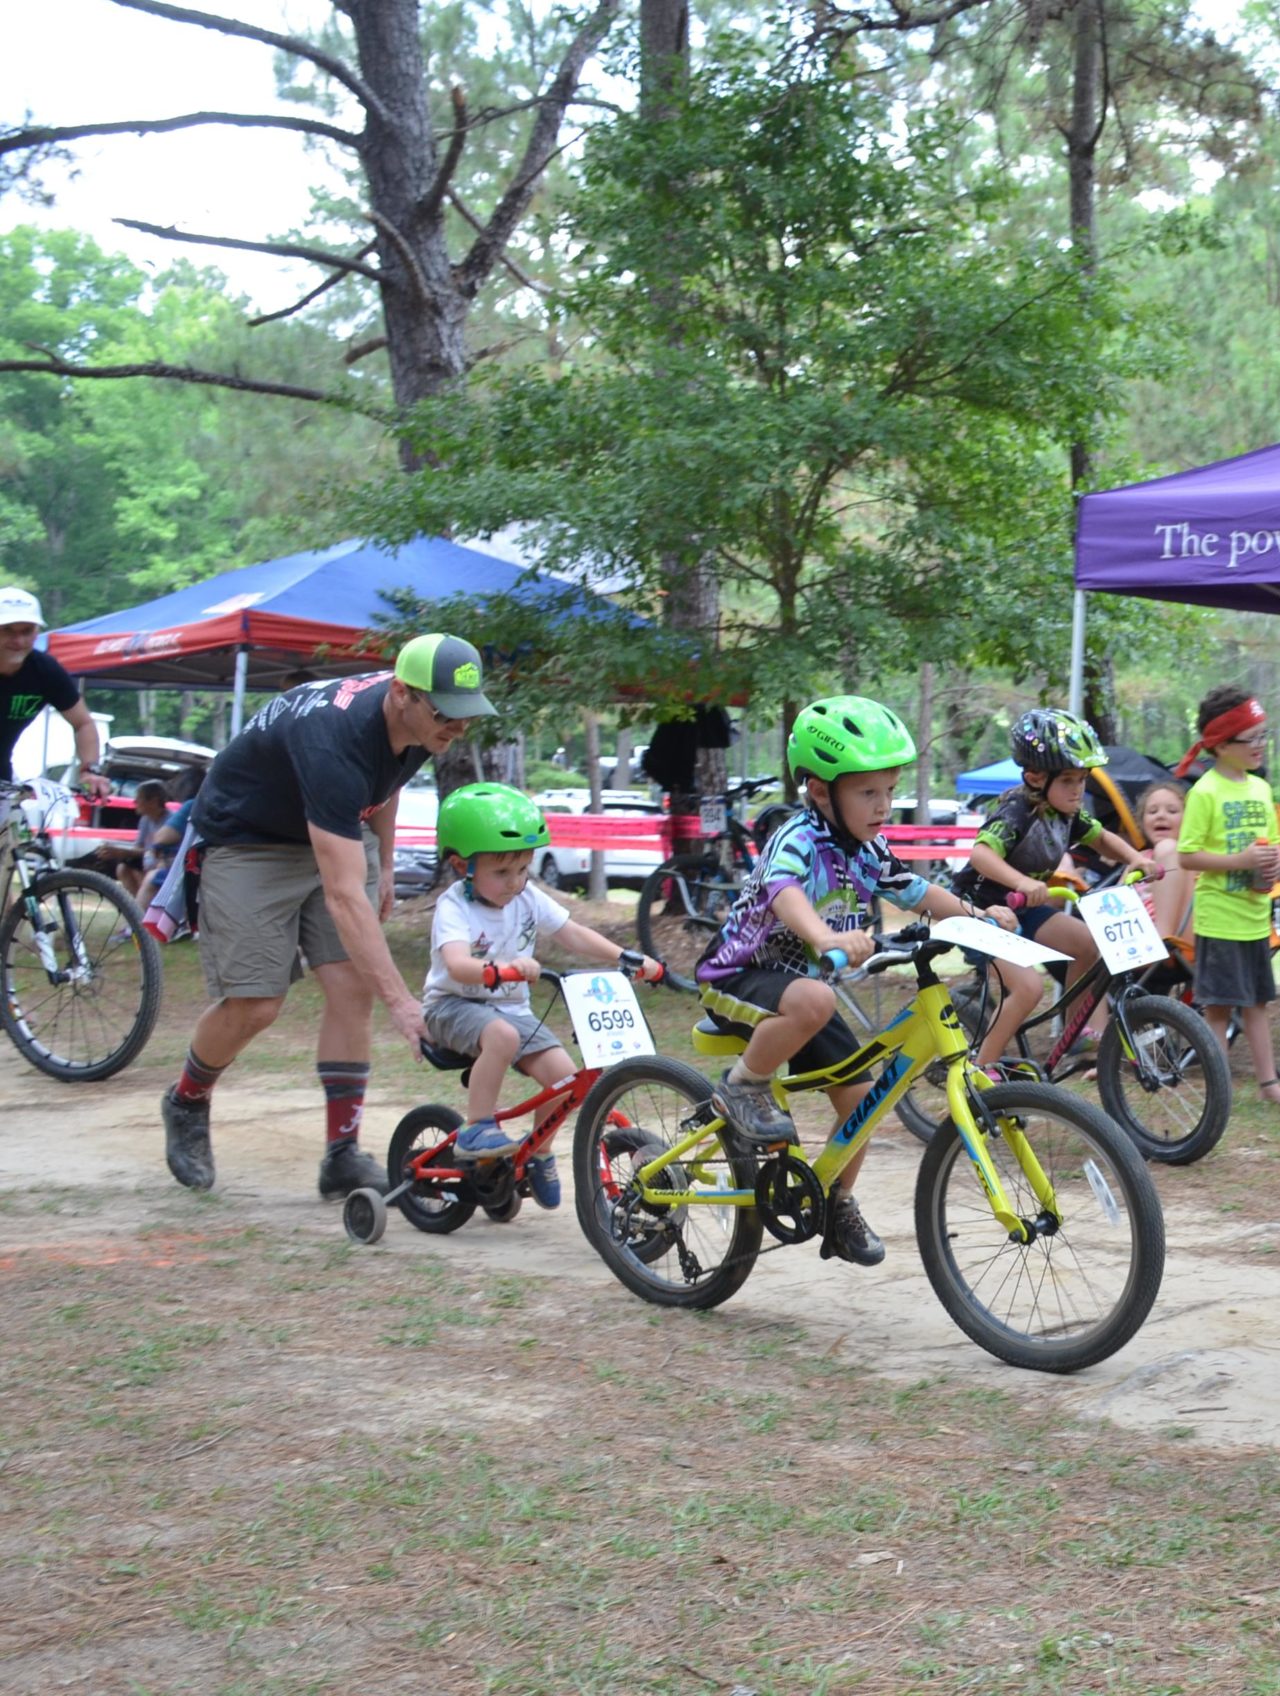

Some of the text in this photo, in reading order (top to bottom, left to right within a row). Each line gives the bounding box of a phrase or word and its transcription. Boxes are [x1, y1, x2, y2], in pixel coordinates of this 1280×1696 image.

[1154, 522, 1219, 559] The
[816, 730, 846, 752] GIRO
[1103, 917, 1145, 943] 6771
[587, 1008, 635, 1032] 6599
[841, 1056, 903, 1141] GIANT
